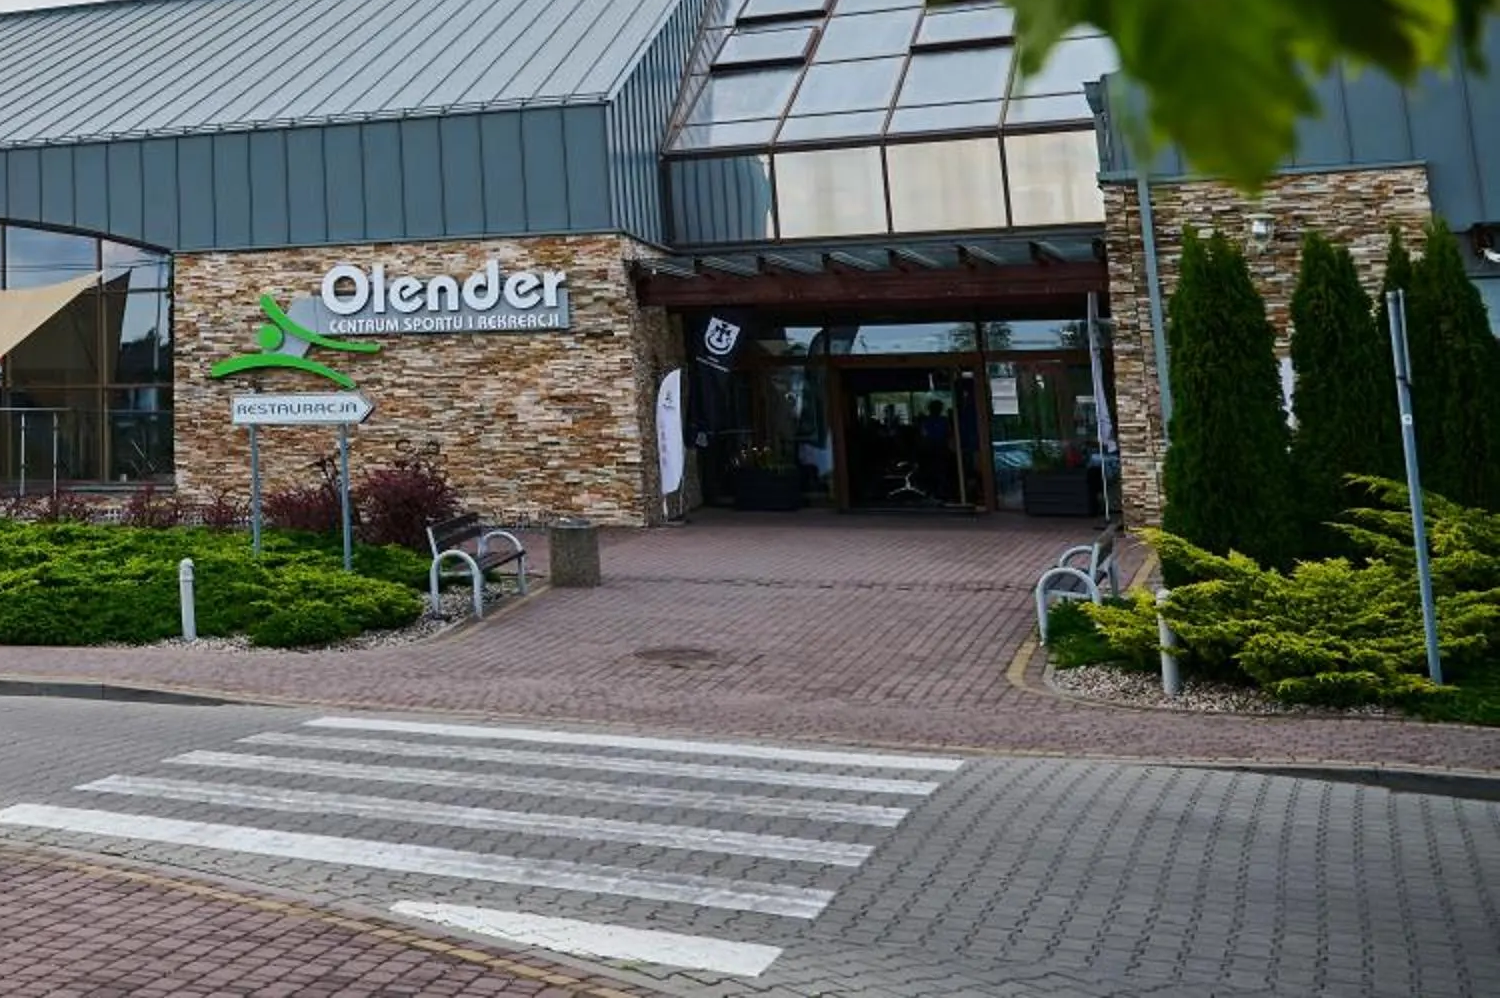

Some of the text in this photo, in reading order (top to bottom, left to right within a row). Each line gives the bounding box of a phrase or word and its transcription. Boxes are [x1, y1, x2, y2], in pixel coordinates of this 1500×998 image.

[321, 259, 566, 315] Olender
[329, 318, 399, 334] CENTRUM
[403, 316, 462, 331] SPORTU
[478, 313, 560, 330] REKREACJI
[237, 401, 357, 415] RESTAURACJA
